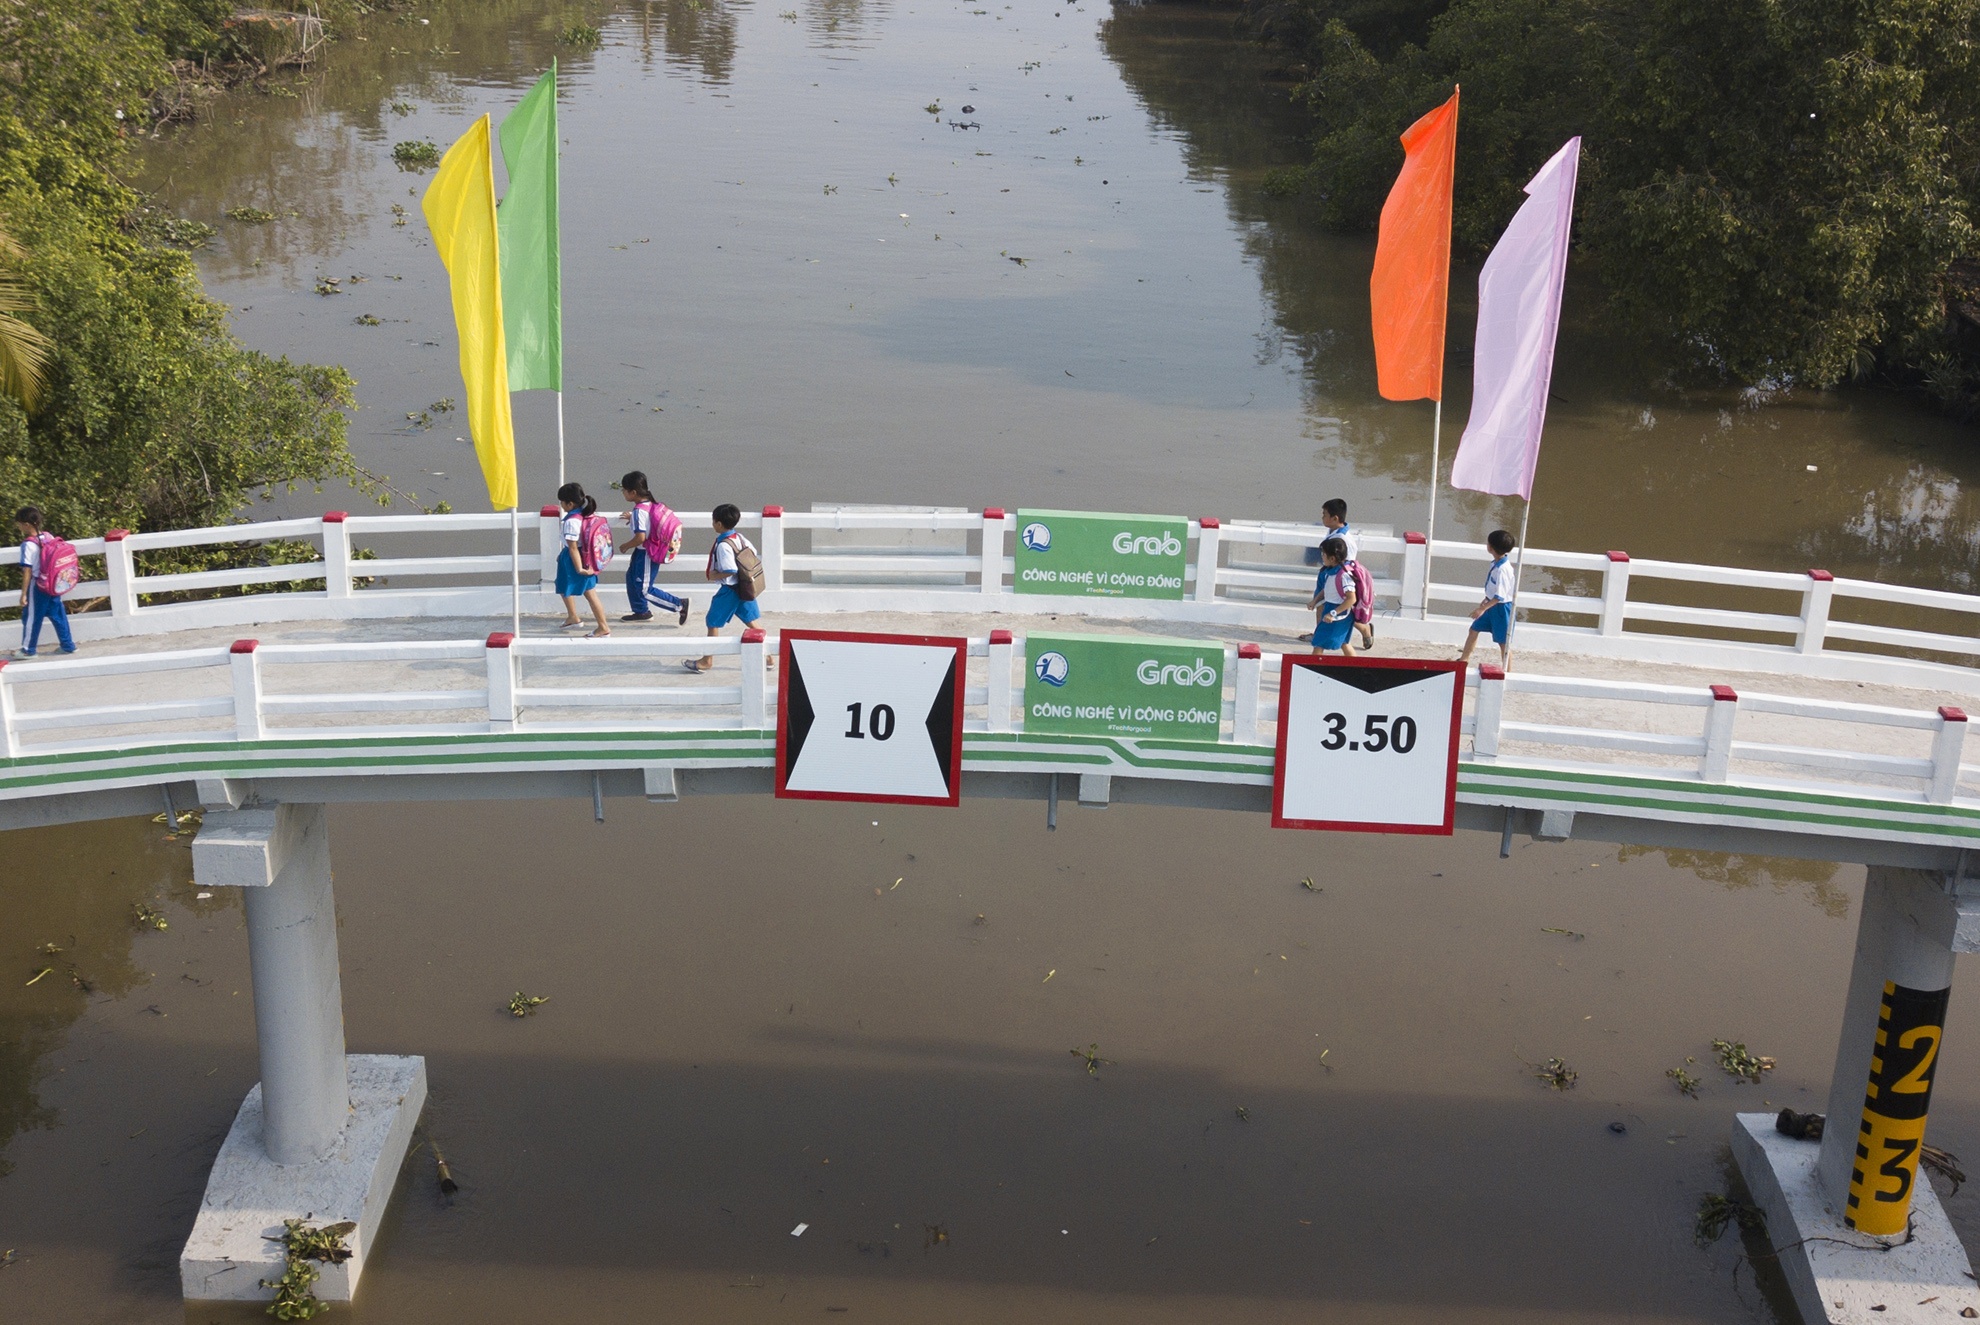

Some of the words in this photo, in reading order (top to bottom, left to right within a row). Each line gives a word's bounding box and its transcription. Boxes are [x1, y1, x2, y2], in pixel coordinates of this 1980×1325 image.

[1112, 530, 1182, 556] Grab
[1022, 569, 1057, 582] CÔNG
[1059, 570, 1094, 585] NGHỆ
[1096, 571, 1108, 585] VÌ
[1110, 572, 1145, 587] CỘNG
[1136, 658, 1217, 687] Grab
[844, 701, 896, 741] 10
[1032, 702, 1072, 718] CÔNG
[1075, 702, 1115, 721] NGHỆ
[1118, 704, 1132, 720] VÌ
[1135, 705, 1175, 724] CỘNG
[1107, 724, 1152, 733] #Techforgood
[1320, 711, 1418, 754] 3.50
[1890, 1025, 1942, 1094] 2
[1874, 1138, 1919, 1203] 3
